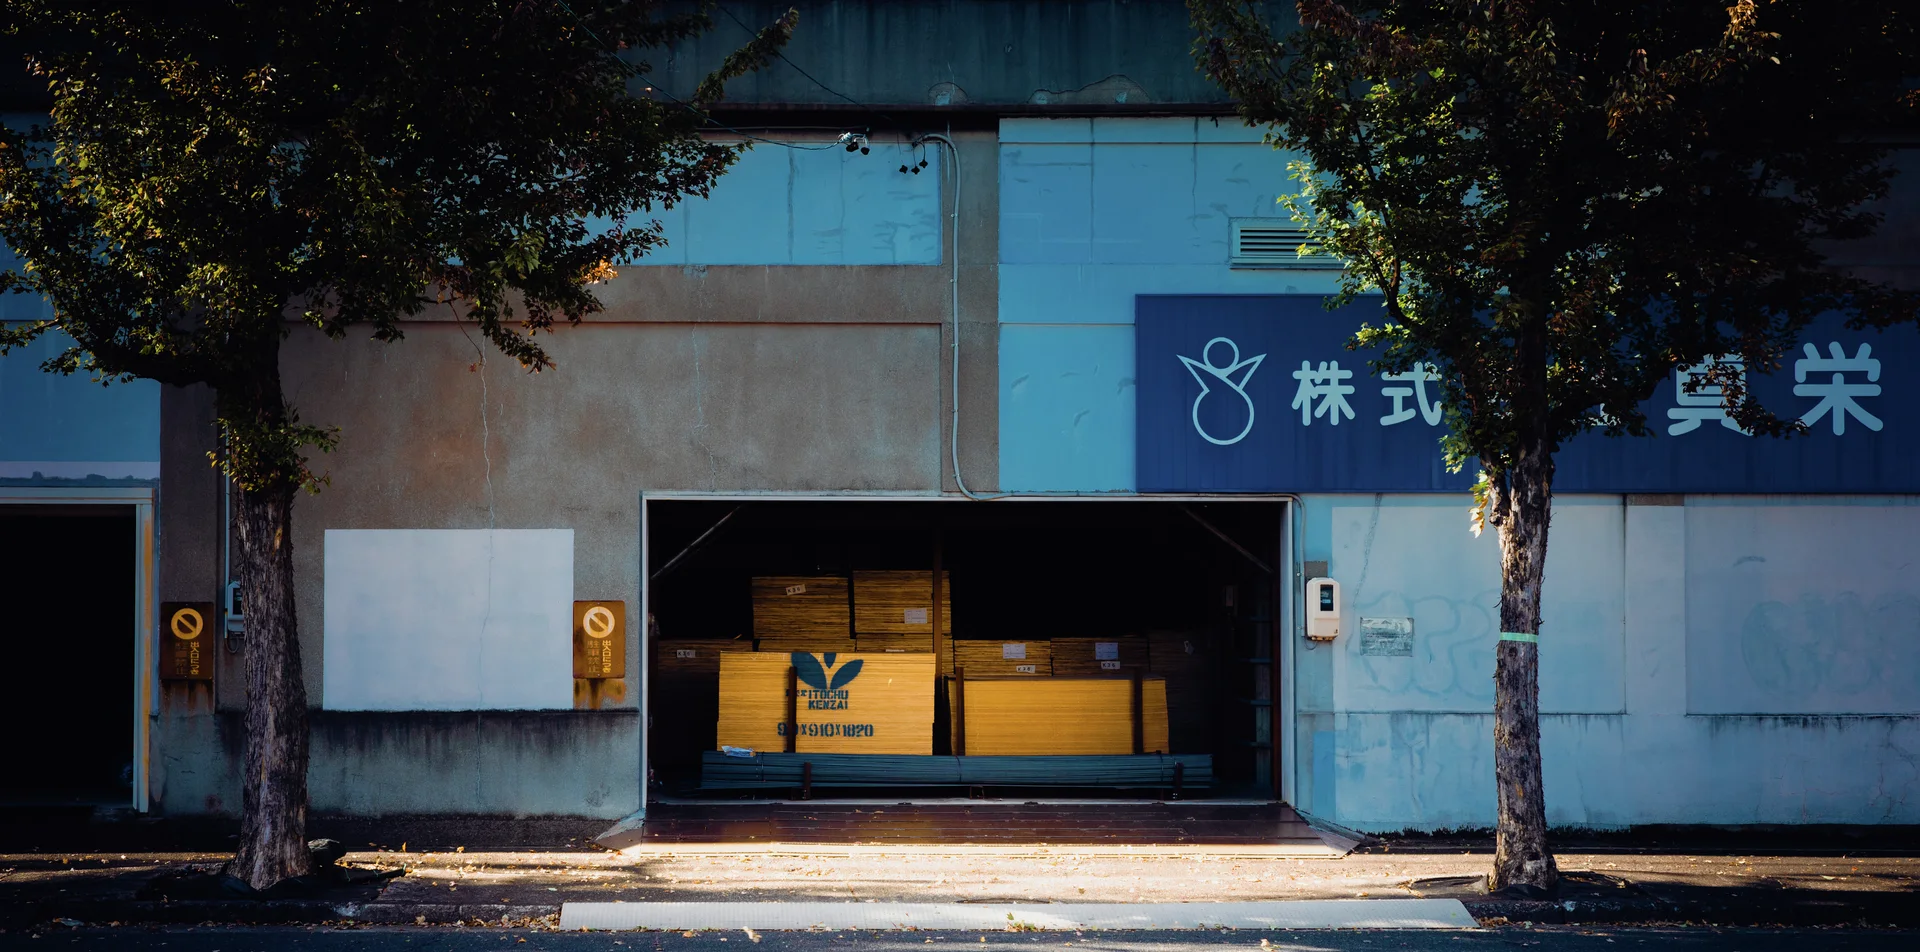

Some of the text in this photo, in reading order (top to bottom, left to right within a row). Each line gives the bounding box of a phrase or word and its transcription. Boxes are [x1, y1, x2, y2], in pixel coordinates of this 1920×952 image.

[190, 641, 200, 675] 出入口につき
[602, 640, 612, 673] 出入口につき
[808, 689, 849, 699] ITOCHU
[808, 700, 849, 710] KENZAI
